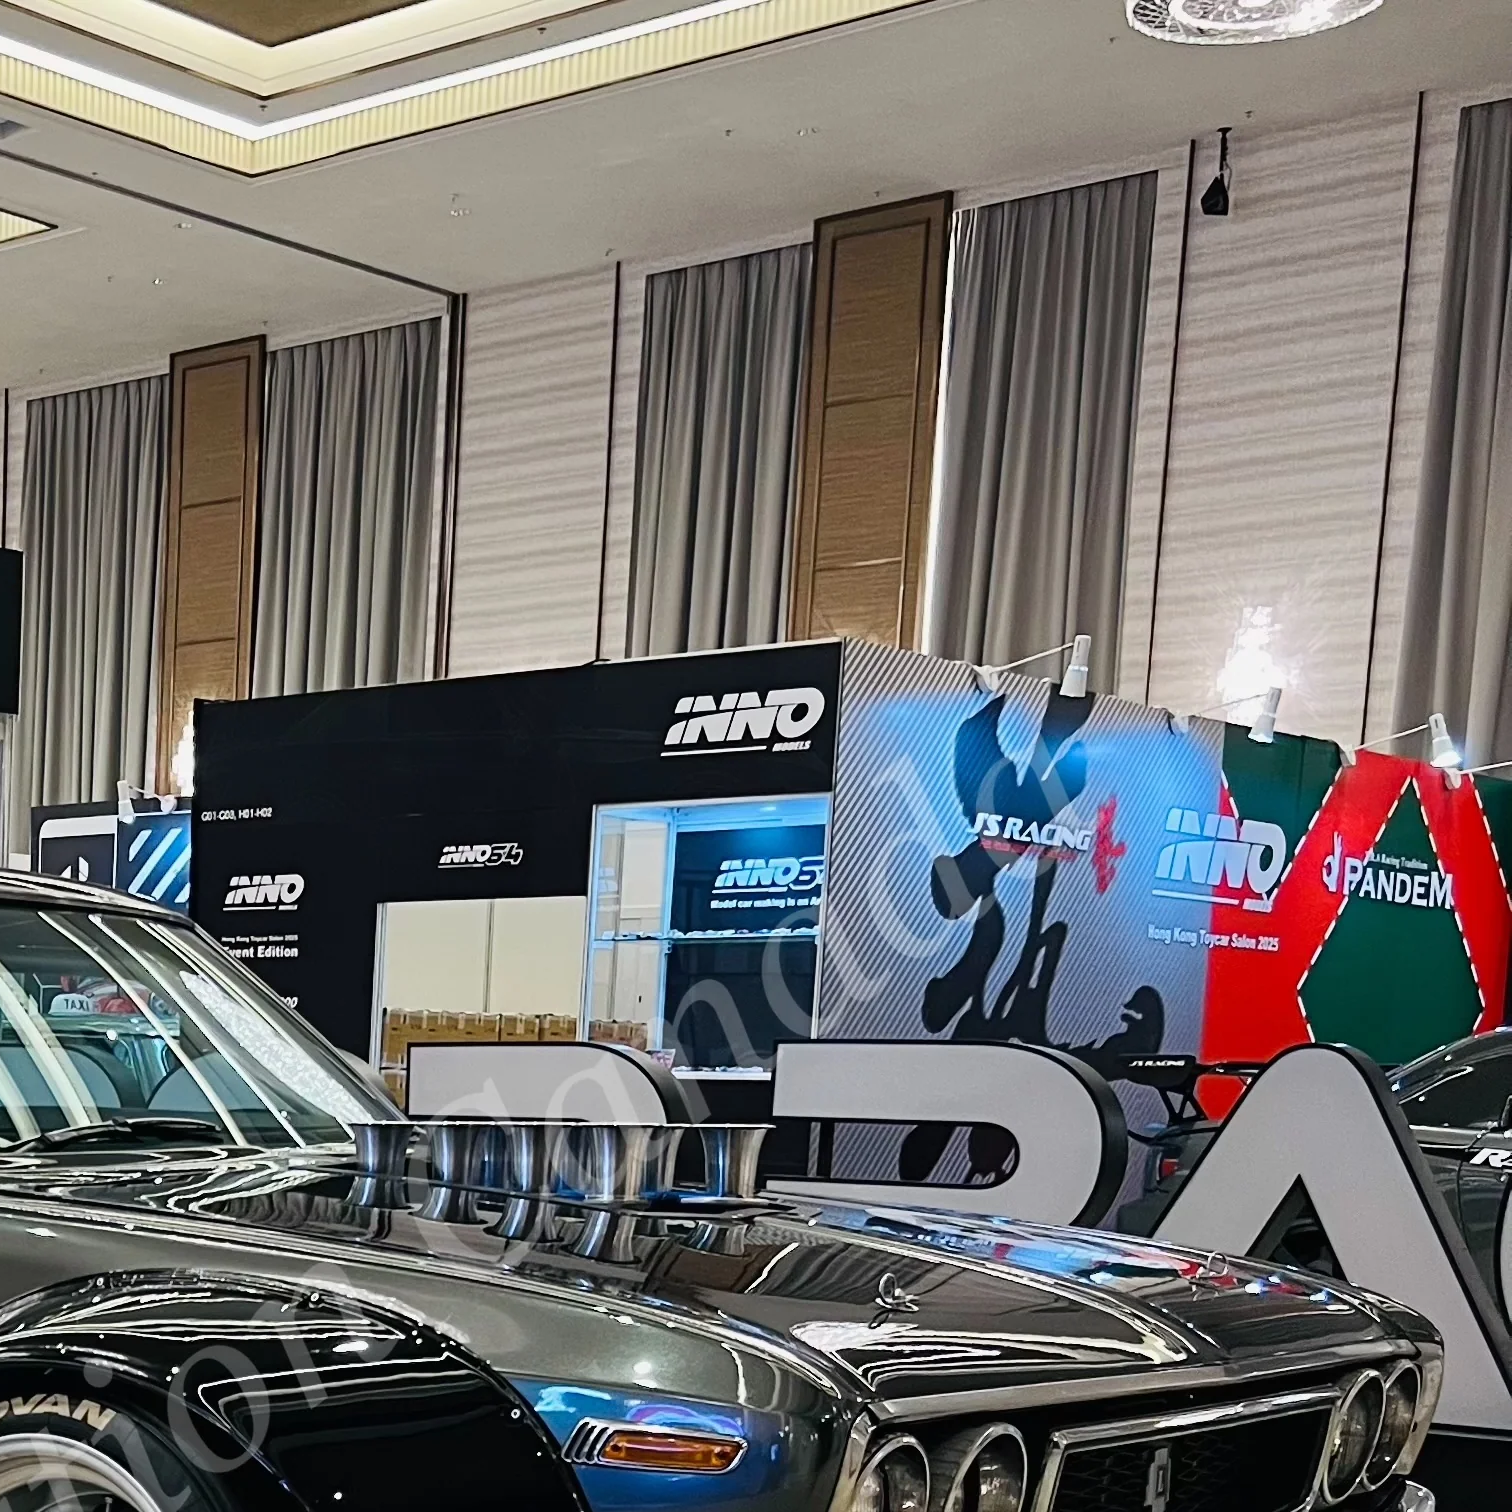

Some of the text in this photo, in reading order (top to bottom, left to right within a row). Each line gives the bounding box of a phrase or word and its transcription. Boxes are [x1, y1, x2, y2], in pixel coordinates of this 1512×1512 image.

[664, 686, 826, 746] INNO
[1003, 816, 1094, 851] RACING
[1155, 807, 1287, 894] INNO
[224, 873, 305, 905] INNO
[713, 855, 825, 891] INNO6
[1343, 856, 1454, 910] PANDEM
[257, 945, 299, 958] Edition
[1173, 927, 1198, 947] Kong
[63, 998, 90, 1011] TAXI
